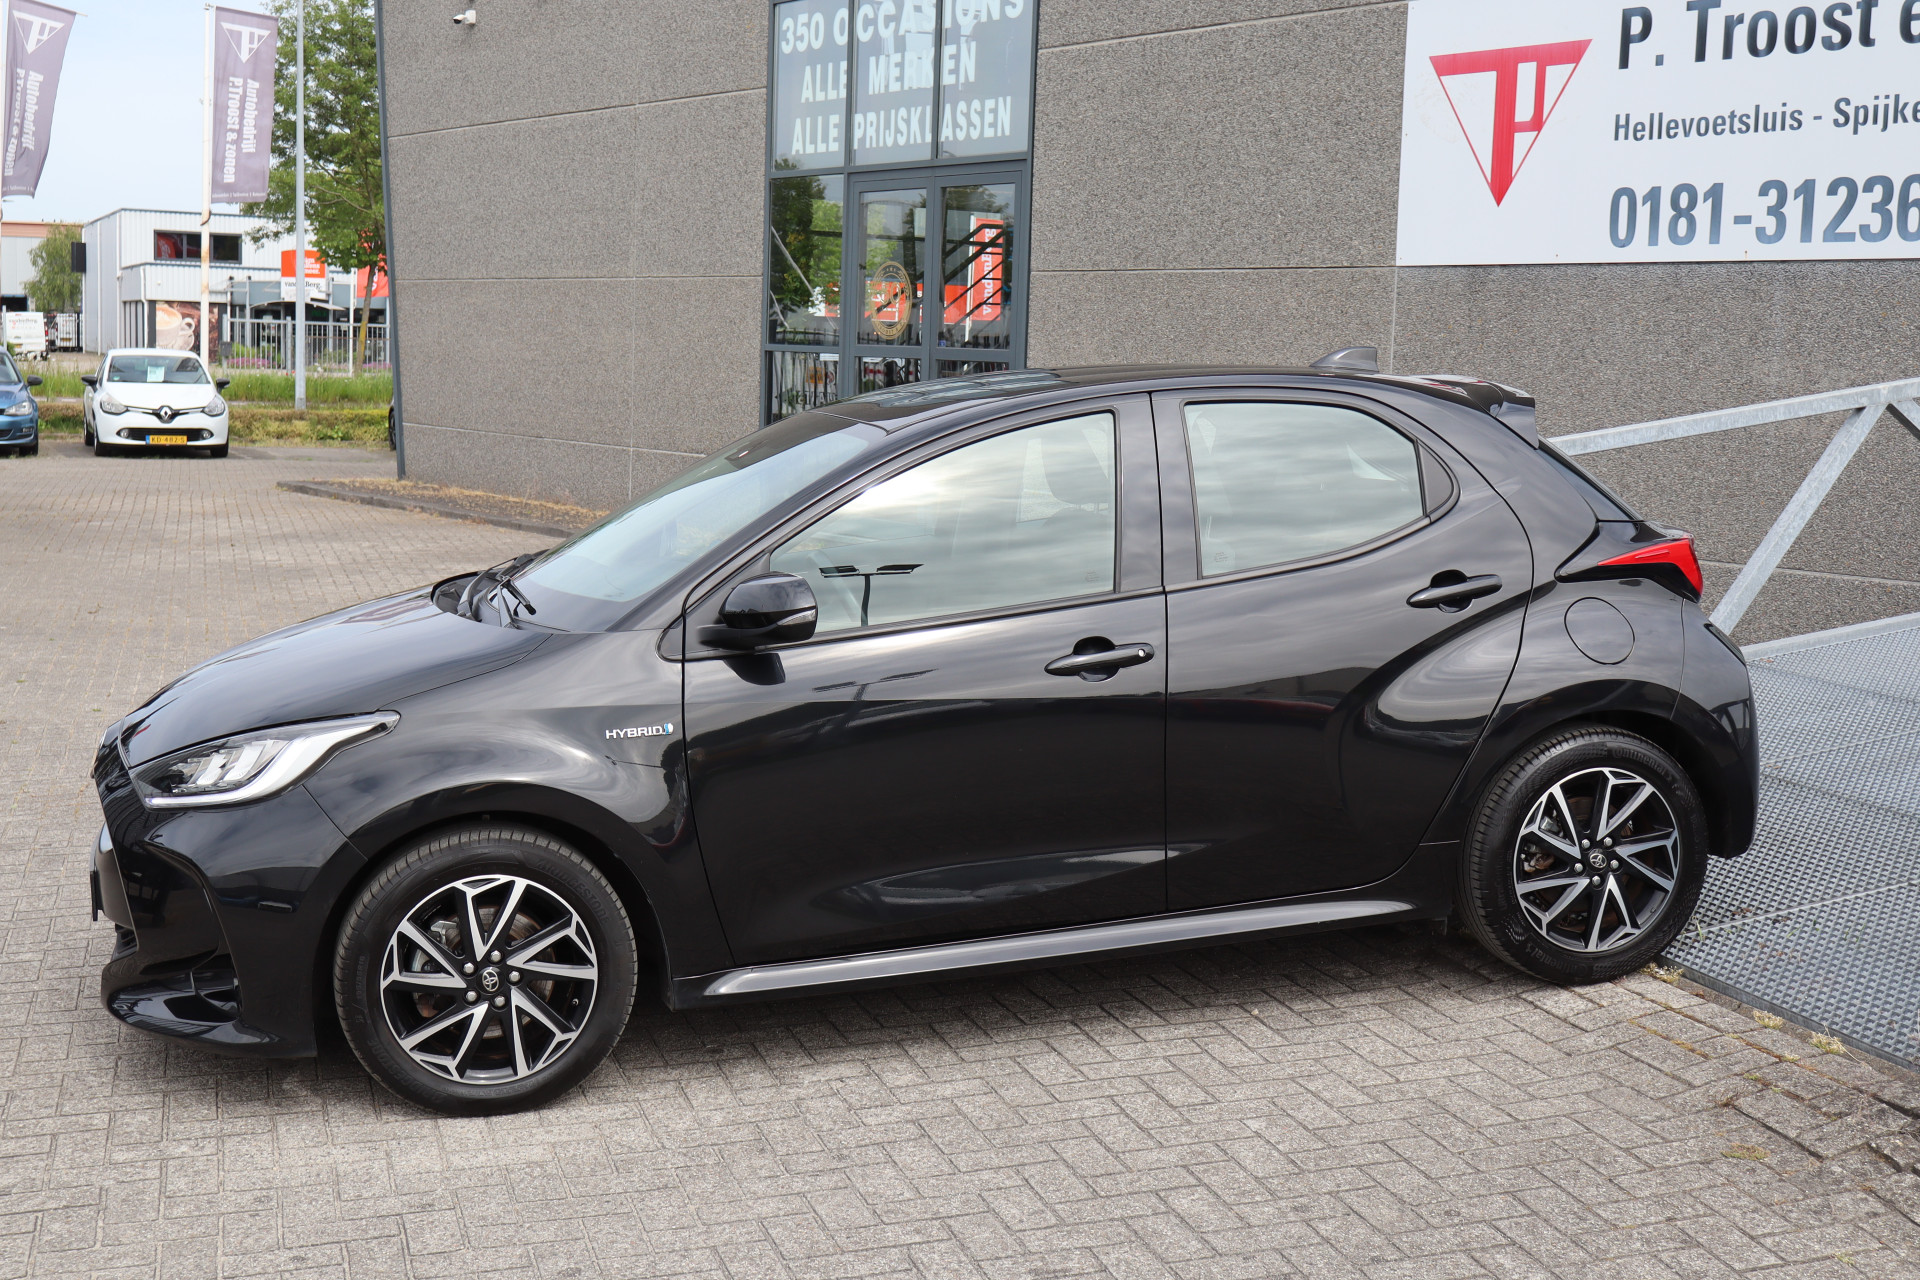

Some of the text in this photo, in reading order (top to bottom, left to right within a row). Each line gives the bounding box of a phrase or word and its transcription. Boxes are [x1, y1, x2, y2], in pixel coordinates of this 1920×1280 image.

[781, 12, 825, 54] 350
[1618, 6, 1664, 70] P.
[1686, 0, 1878, 62] Troost
[801, 41, 976, 103] ALLE MERKEN
[22, 70, 44, 151] Autobedrijf
[223, 76, 243, 183] P.Troost & zonen
[241, 78, 260, 153] Autobedrijf
[792, 96, 1012, 155] ALLE PRIJSKLASSEN
[1613, 102, 1803, 141] Hellevoetsluis
[1833, 93, 1920, 136] Spijke
[4, 136, 17, 177] zonen
[1608, 173, 1920, 249] 0181-31236
[605, 725, 662, 740] HYBRID
[536, 857, 610, 922] BRIDGESTONE
